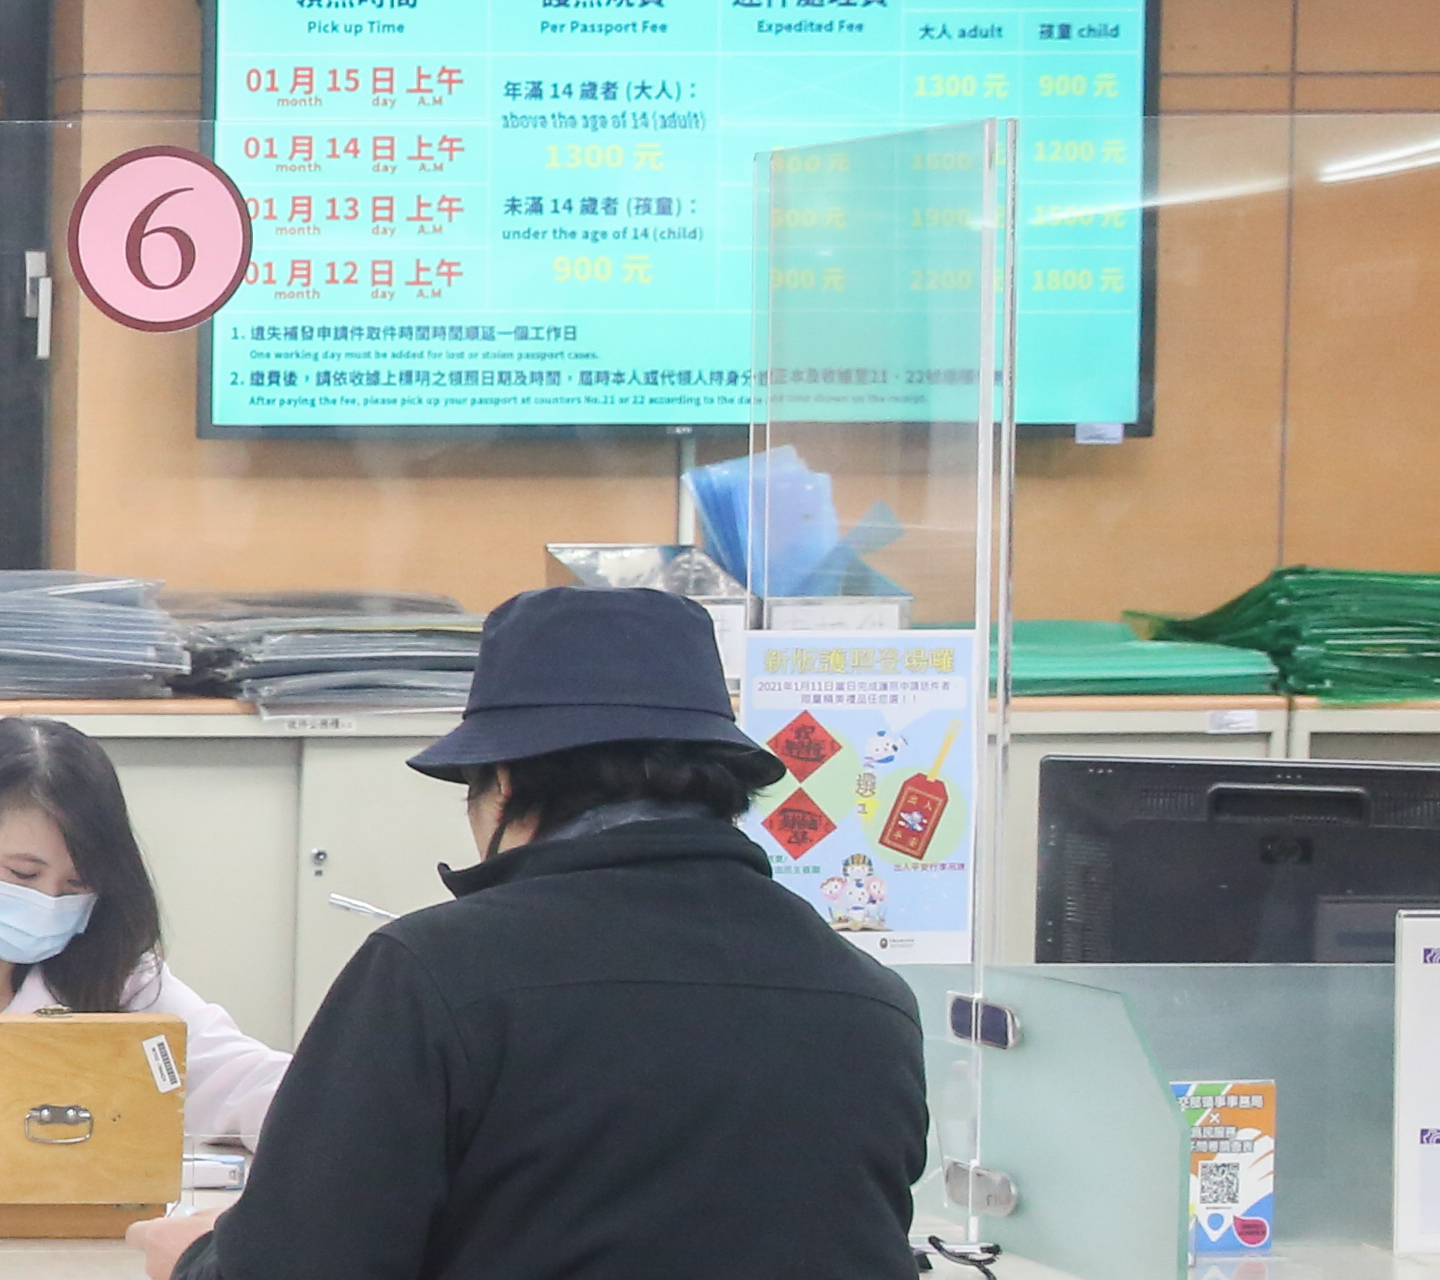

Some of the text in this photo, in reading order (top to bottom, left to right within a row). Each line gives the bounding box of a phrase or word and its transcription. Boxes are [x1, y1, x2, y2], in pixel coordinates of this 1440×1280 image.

[307, 20, 406, 37] Pick up Time
[540, 20, 669, 36] Per Passport Fee
[756, 20, 865, 35] Expedited Fee
[919, 24, 1003, 41] 大人 adult
[1076, 23, 1121, 40] child
[246, 68, 280, 93] 01
[326, 68, 361, 93] 15
[405, 65, 465, 95] 上午
[277, 96, 323, 108] month
[371, 96, 398, 110] day
[244, 136, 279, 159] 01
[326, 136, 361, 159] 14
[406, 134, 466, 162] 上午
[275, 163, 322, 173] month
[371, 163, 398, 175] day
[326, 197, 360, 221] 13
[405, 194, 465, 223] 上午
[125, 186, 197, 290] 6
[275, 224, 321, 235] month
[371, 224, 397, 237] day
[325, 261, 359, 285] 12
[405, 258, 464, 287] 上午
[274, 289, 321, 299] month
[370, 289, 396, 301] day
